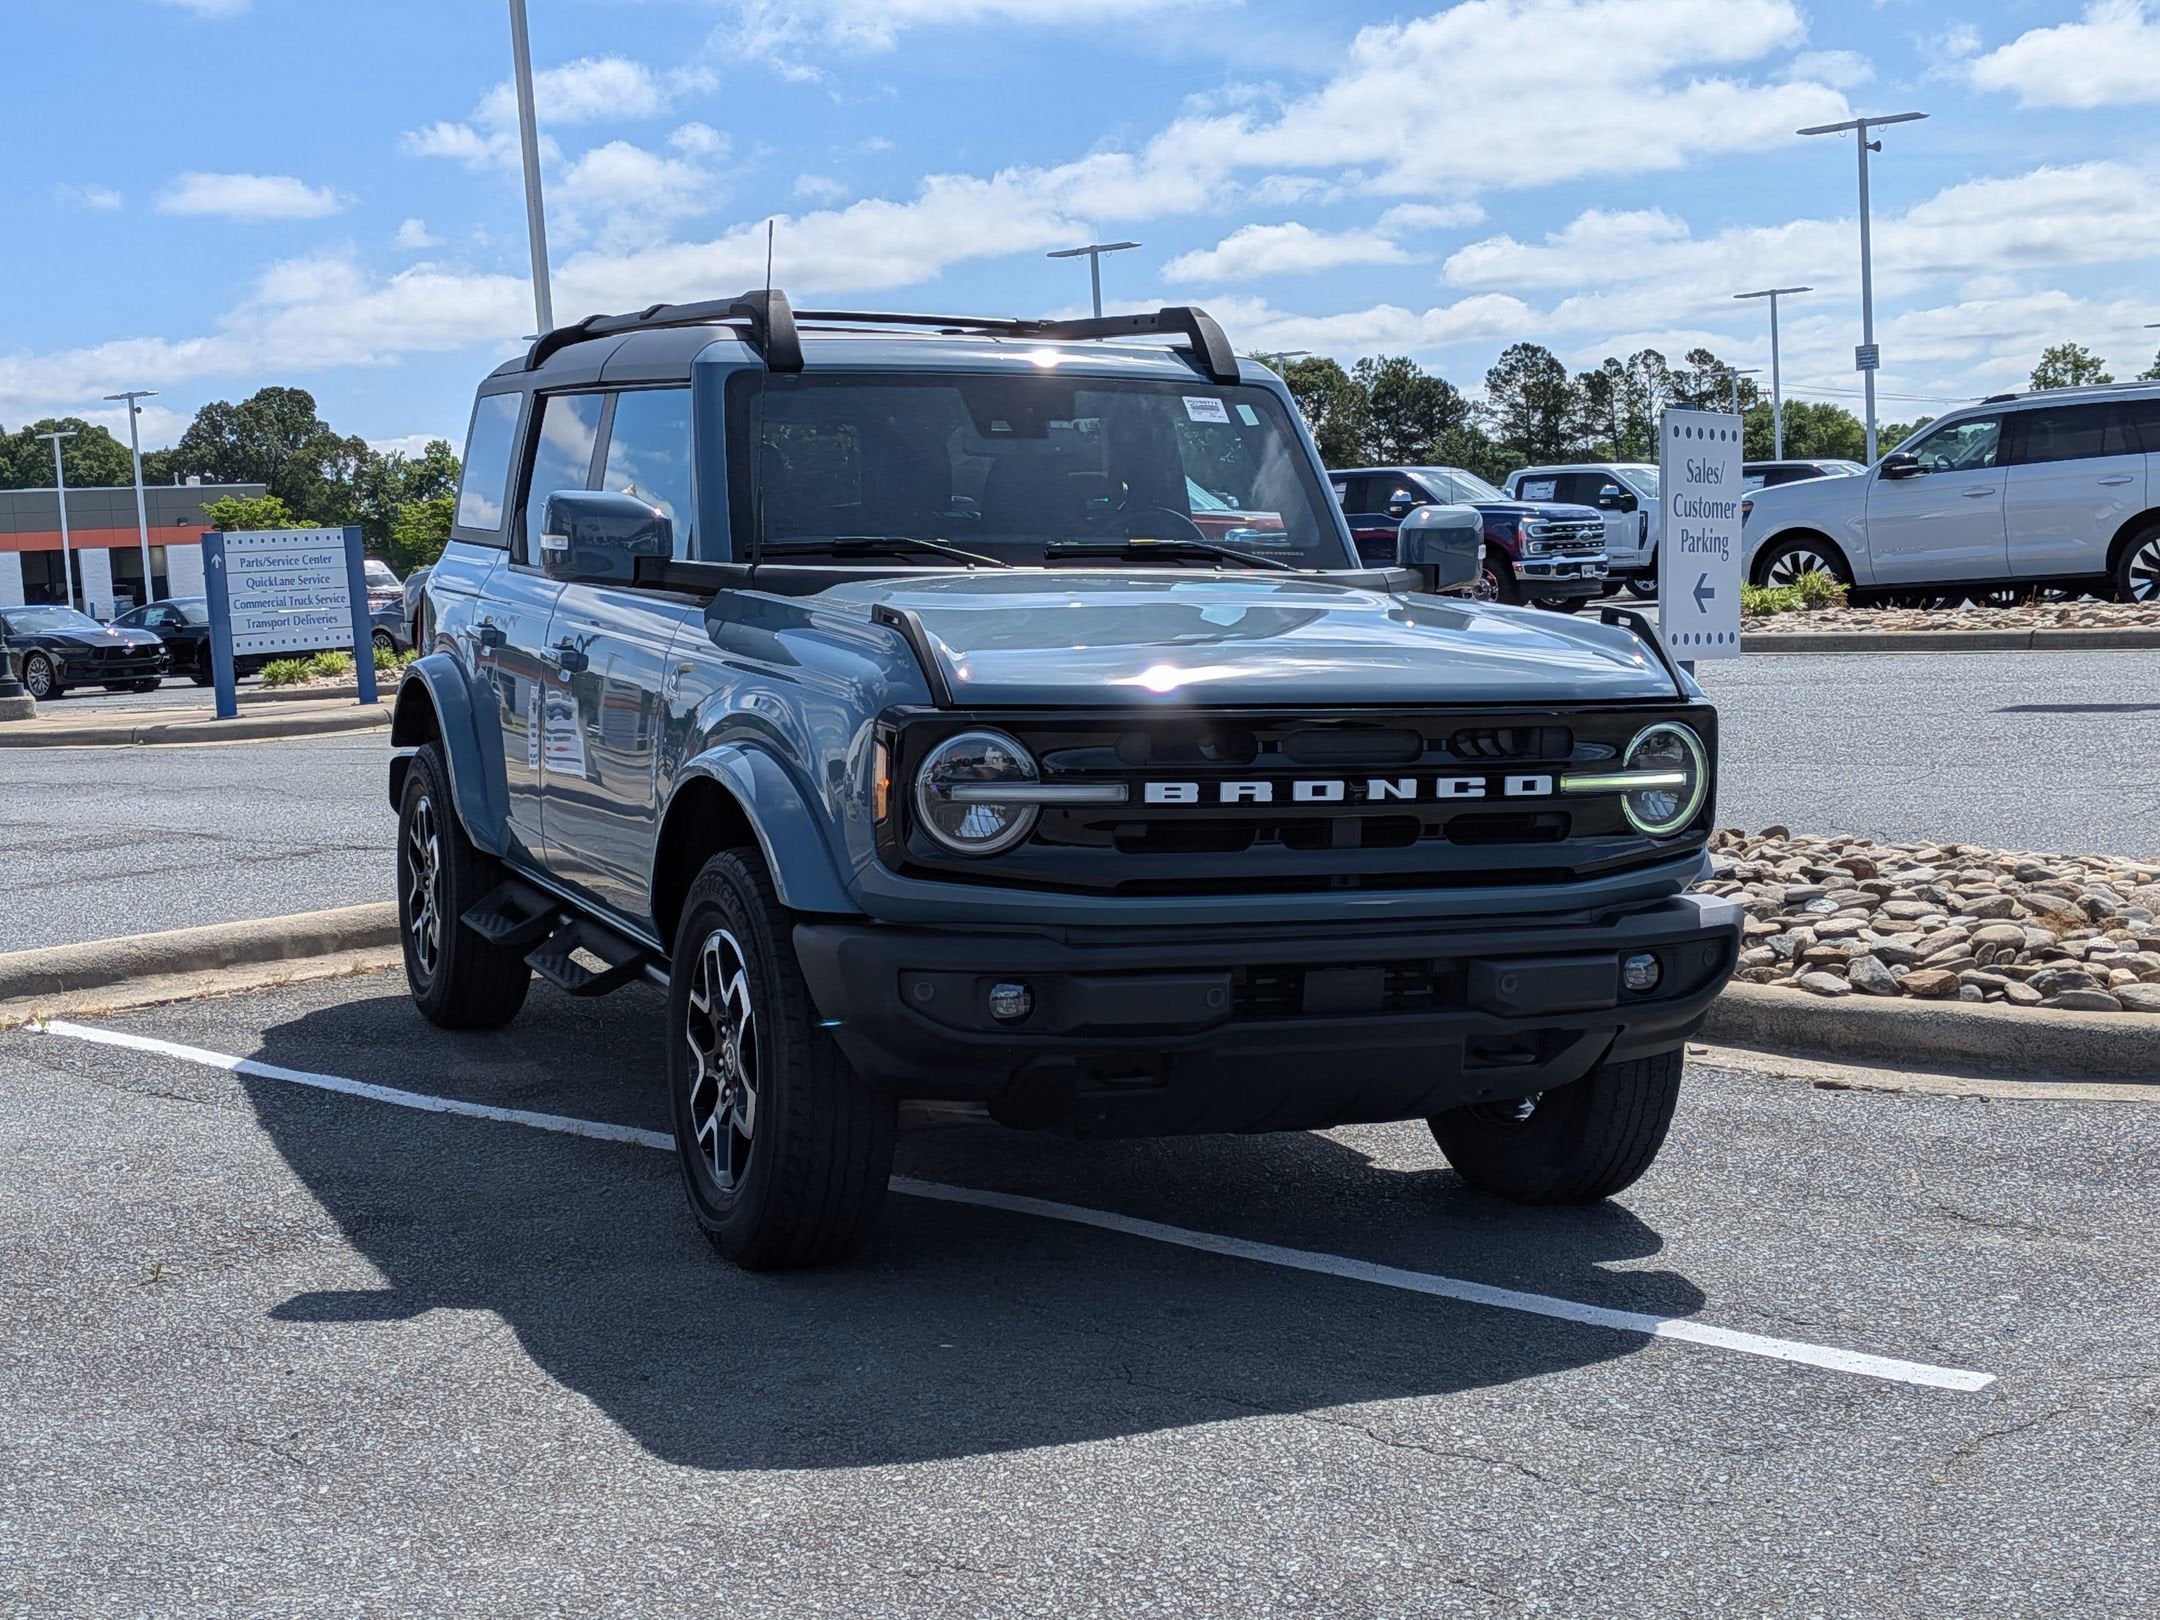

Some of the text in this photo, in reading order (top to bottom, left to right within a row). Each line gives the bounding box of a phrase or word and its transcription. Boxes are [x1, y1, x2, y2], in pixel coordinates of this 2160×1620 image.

[1686, 457, 1726, 485] Sales/
[1673, 493, 1737, 519] Customer
[1680, 527, 1729, 562] Parking
[240, 554, 332, 568] Parts/Service Center
[297, 573, 330, 585] Service
[234, 592, 346, 610] Commercial Truck Service
[246, 614, 338, 631] Transport Deliveries
[1144, 775, 1553, 803] BRONCO
